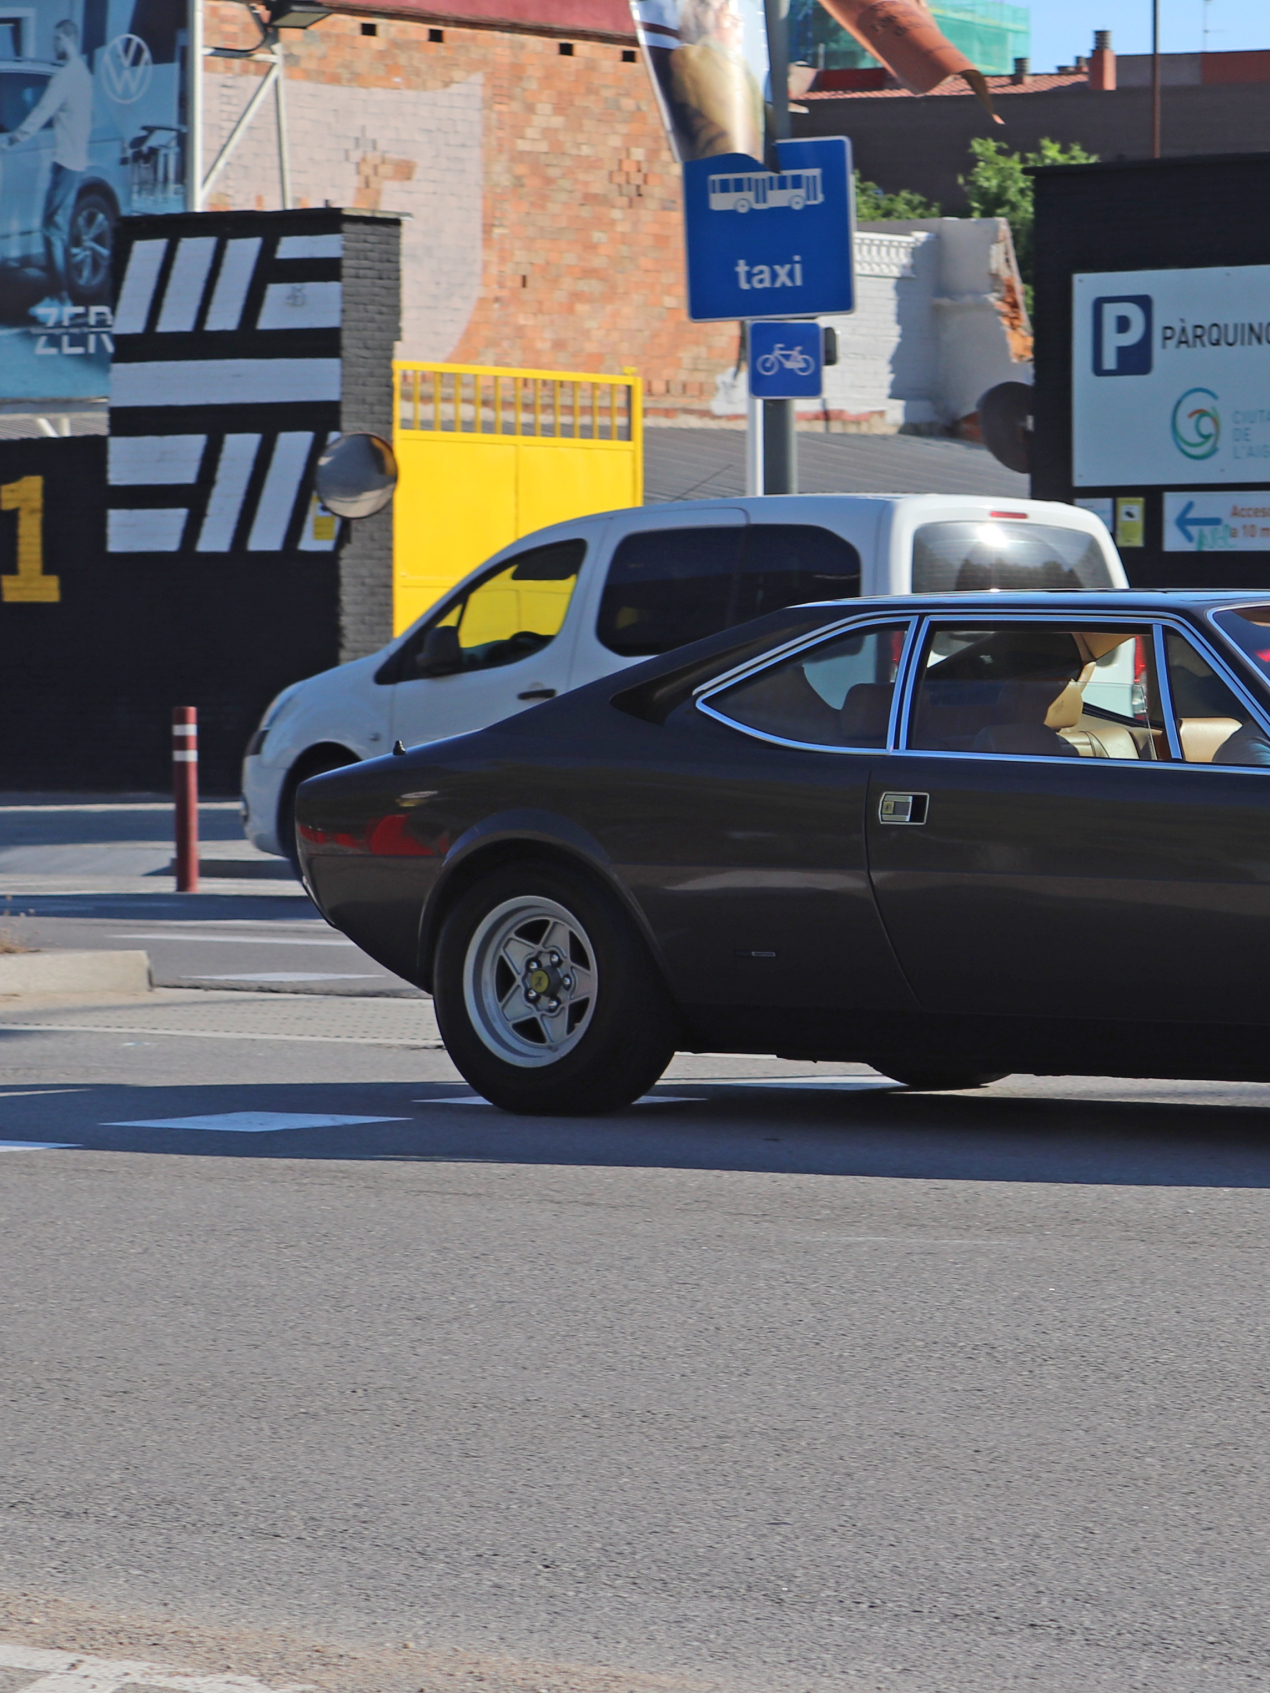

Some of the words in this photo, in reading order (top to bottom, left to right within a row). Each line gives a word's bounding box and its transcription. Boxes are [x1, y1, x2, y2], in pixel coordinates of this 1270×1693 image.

[735, 255, 803, 290] taxi
[1102, 302, 1146, 370] P
[1232, 427, 1251, 442] DE
[0, 475, 60, 602] 1
[1230, 527, 1239, 538] a
[1242, 524, 1257, 538] 10
